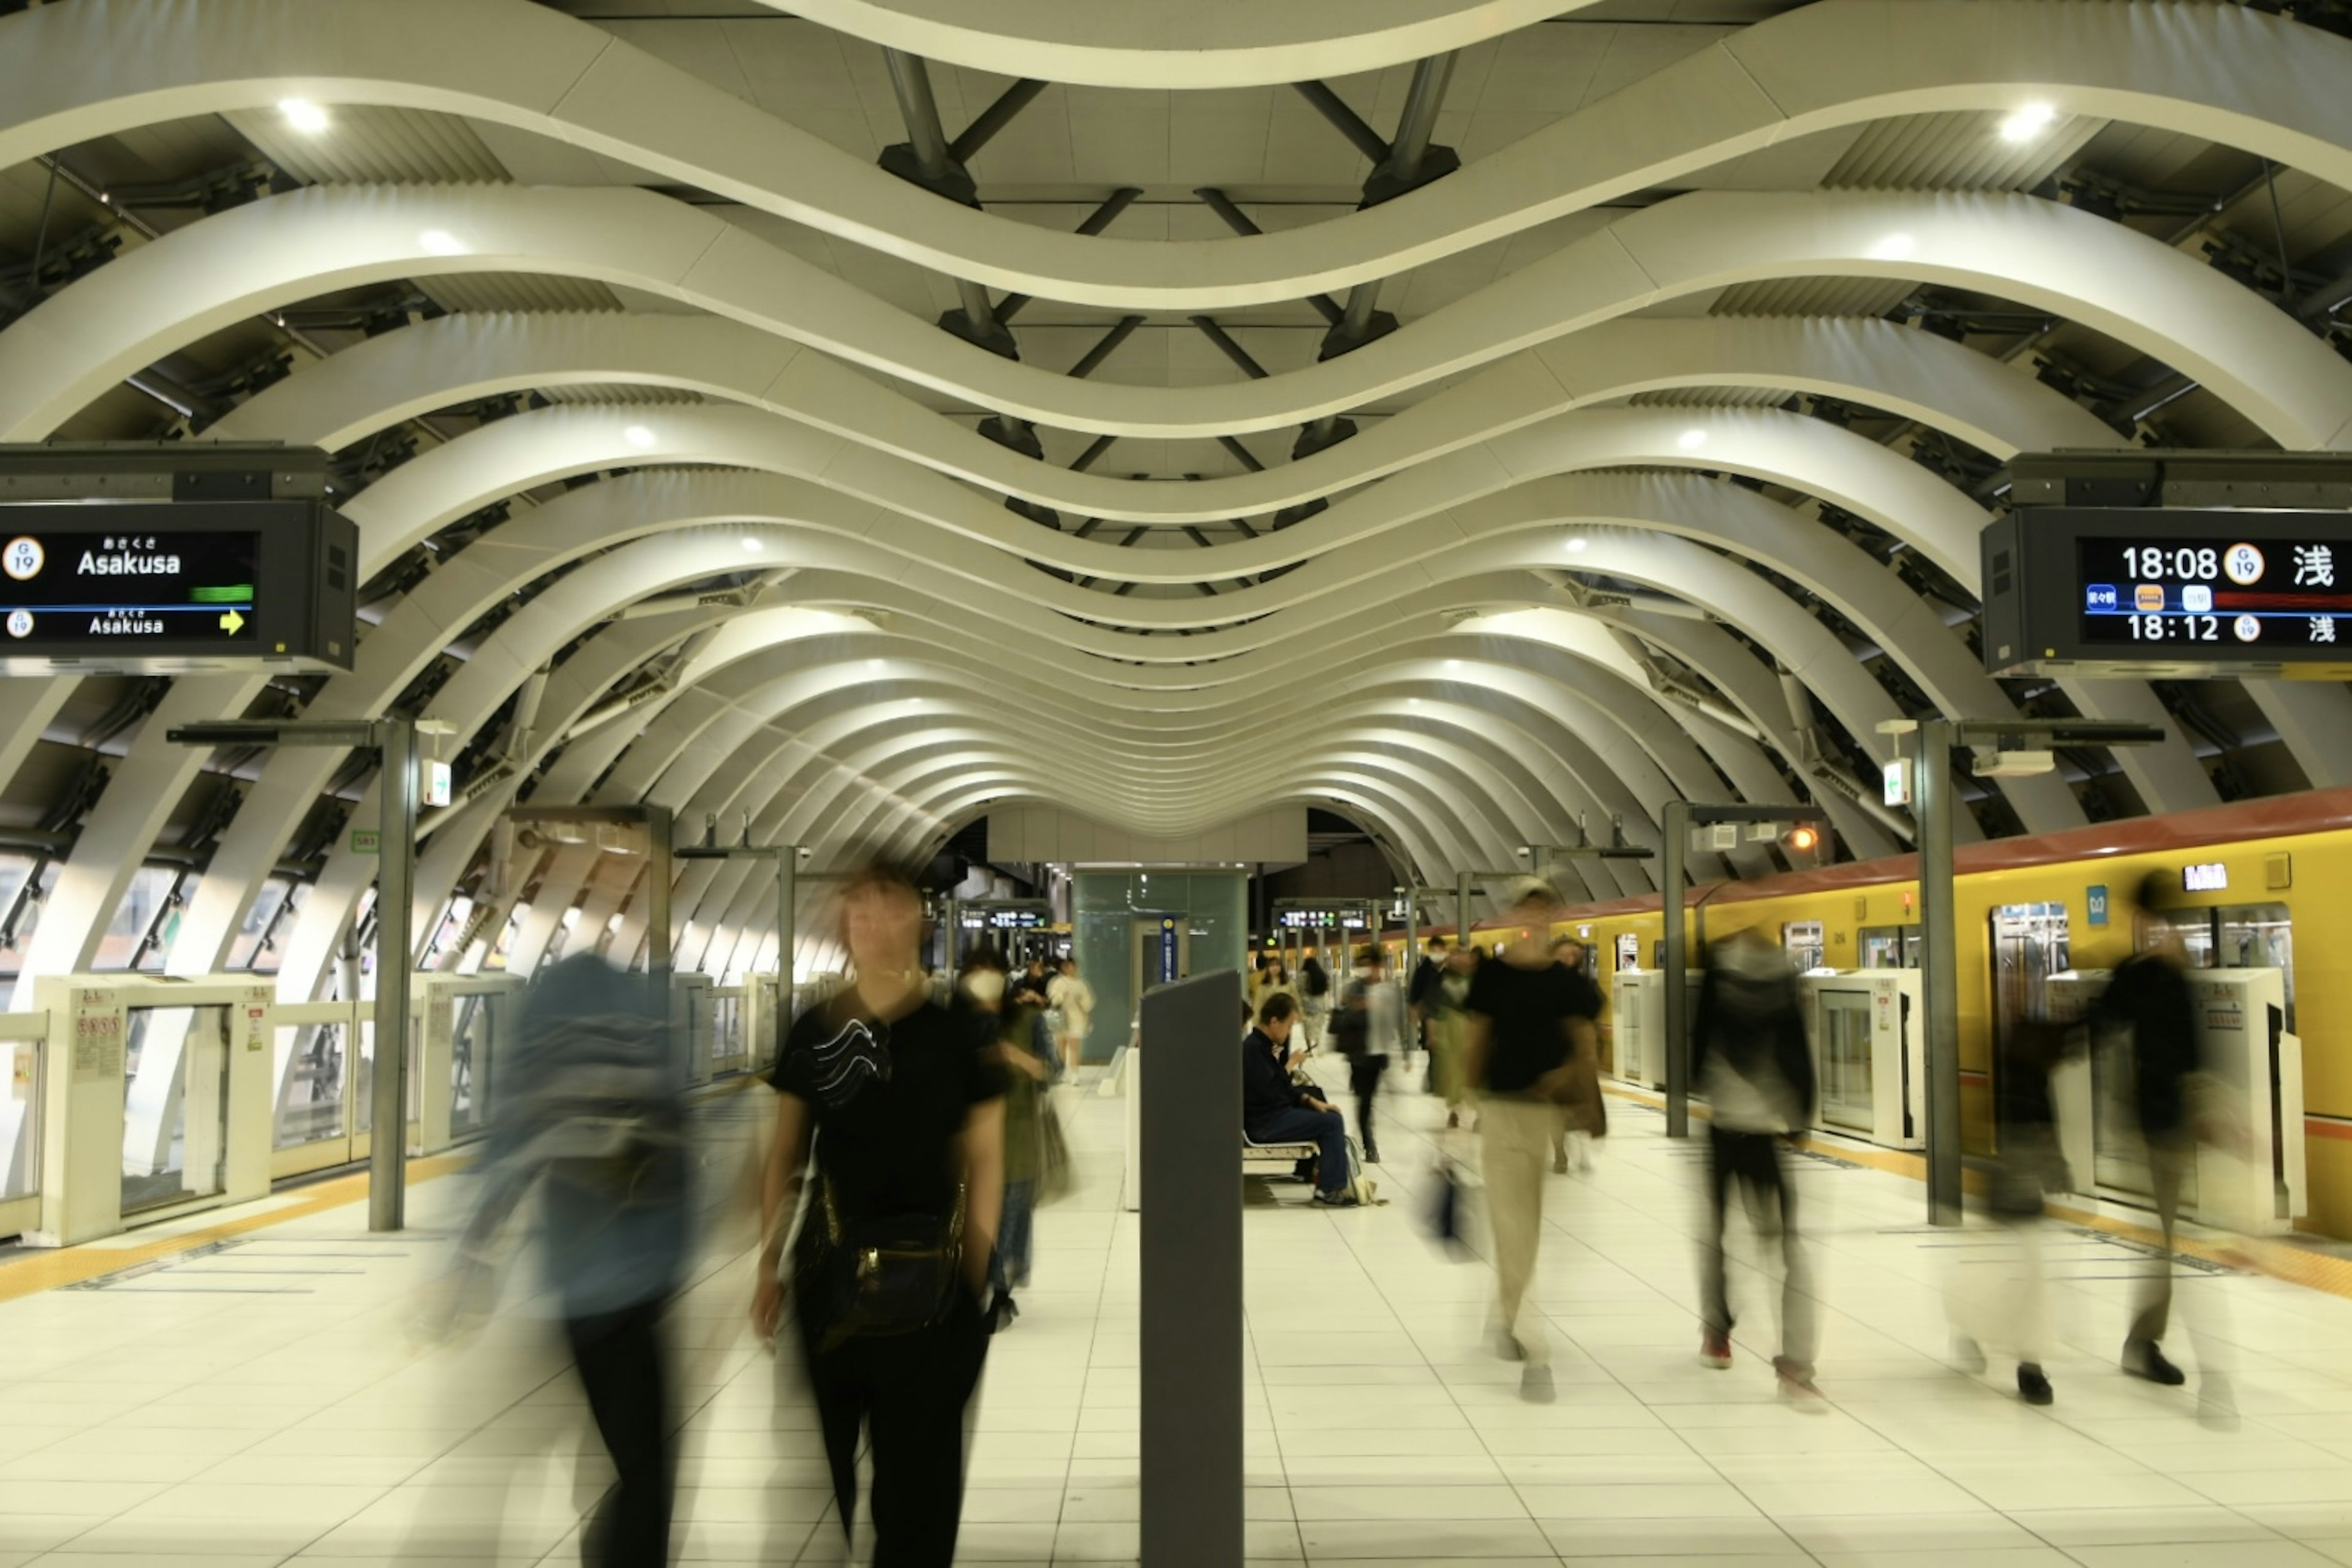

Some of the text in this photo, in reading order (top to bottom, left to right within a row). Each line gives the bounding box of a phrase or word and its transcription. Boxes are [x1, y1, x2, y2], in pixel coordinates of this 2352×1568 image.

[18, 543, 29, 554] G
[2237, 548, 2249, 560] G
[15, 556, 34, 571] 19
[77, 549, 181, 575] Asakusa
[2122, 547, 2218, 580] 18:08
[2236, 562, 2255, 576] 19
[15, 622, 27, 631] 19
[89, 616, 164, 634] Asakusa
[2128, 614, 2218, 640] 18:12
[2241, 626, 2255, 636] 19
